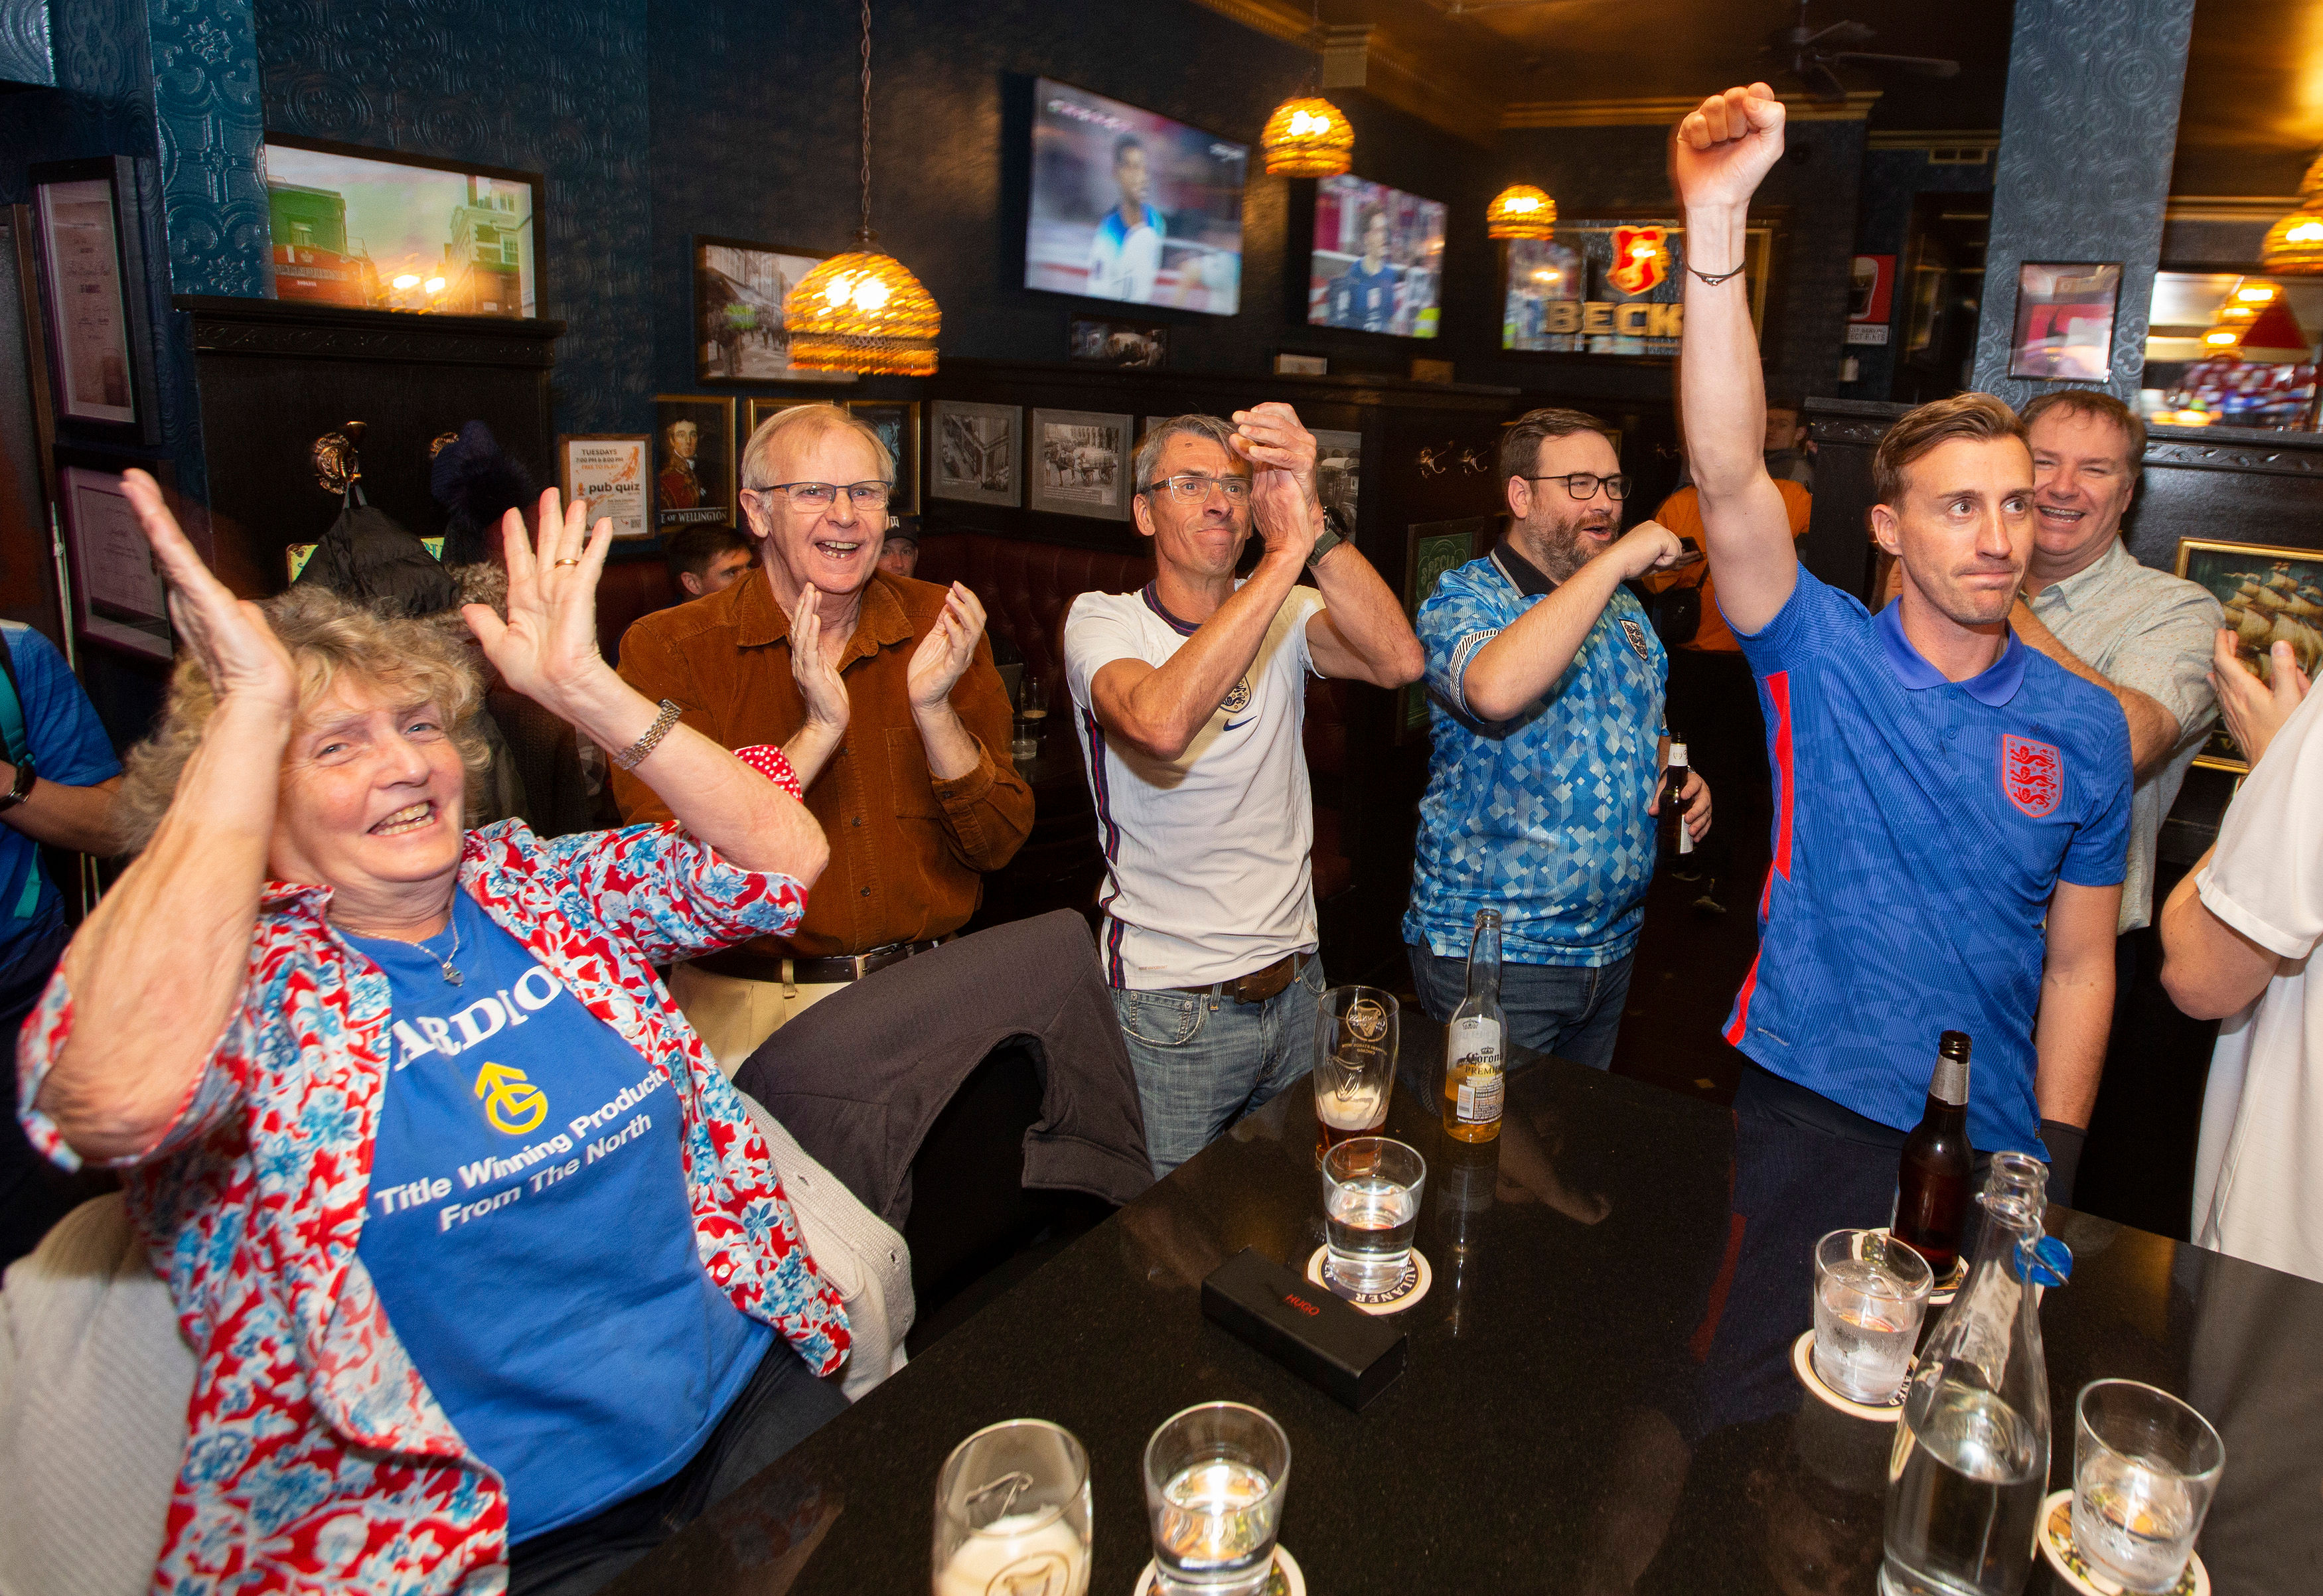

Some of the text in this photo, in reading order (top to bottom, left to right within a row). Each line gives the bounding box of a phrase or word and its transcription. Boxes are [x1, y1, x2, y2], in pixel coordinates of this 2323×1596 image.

[589, 482, 640, 494] pub quiz
[678, 511, 727, 522] WELLINGTON
[374, 1177, 453, 1216] Title
[457, 1133, 574, 1192] Winning
[439, 1112, 652, 1232] From The North
[1356, 1260, 1416, 1303] AULANER
[1285, 1293, 1320, 1316] HUGO
